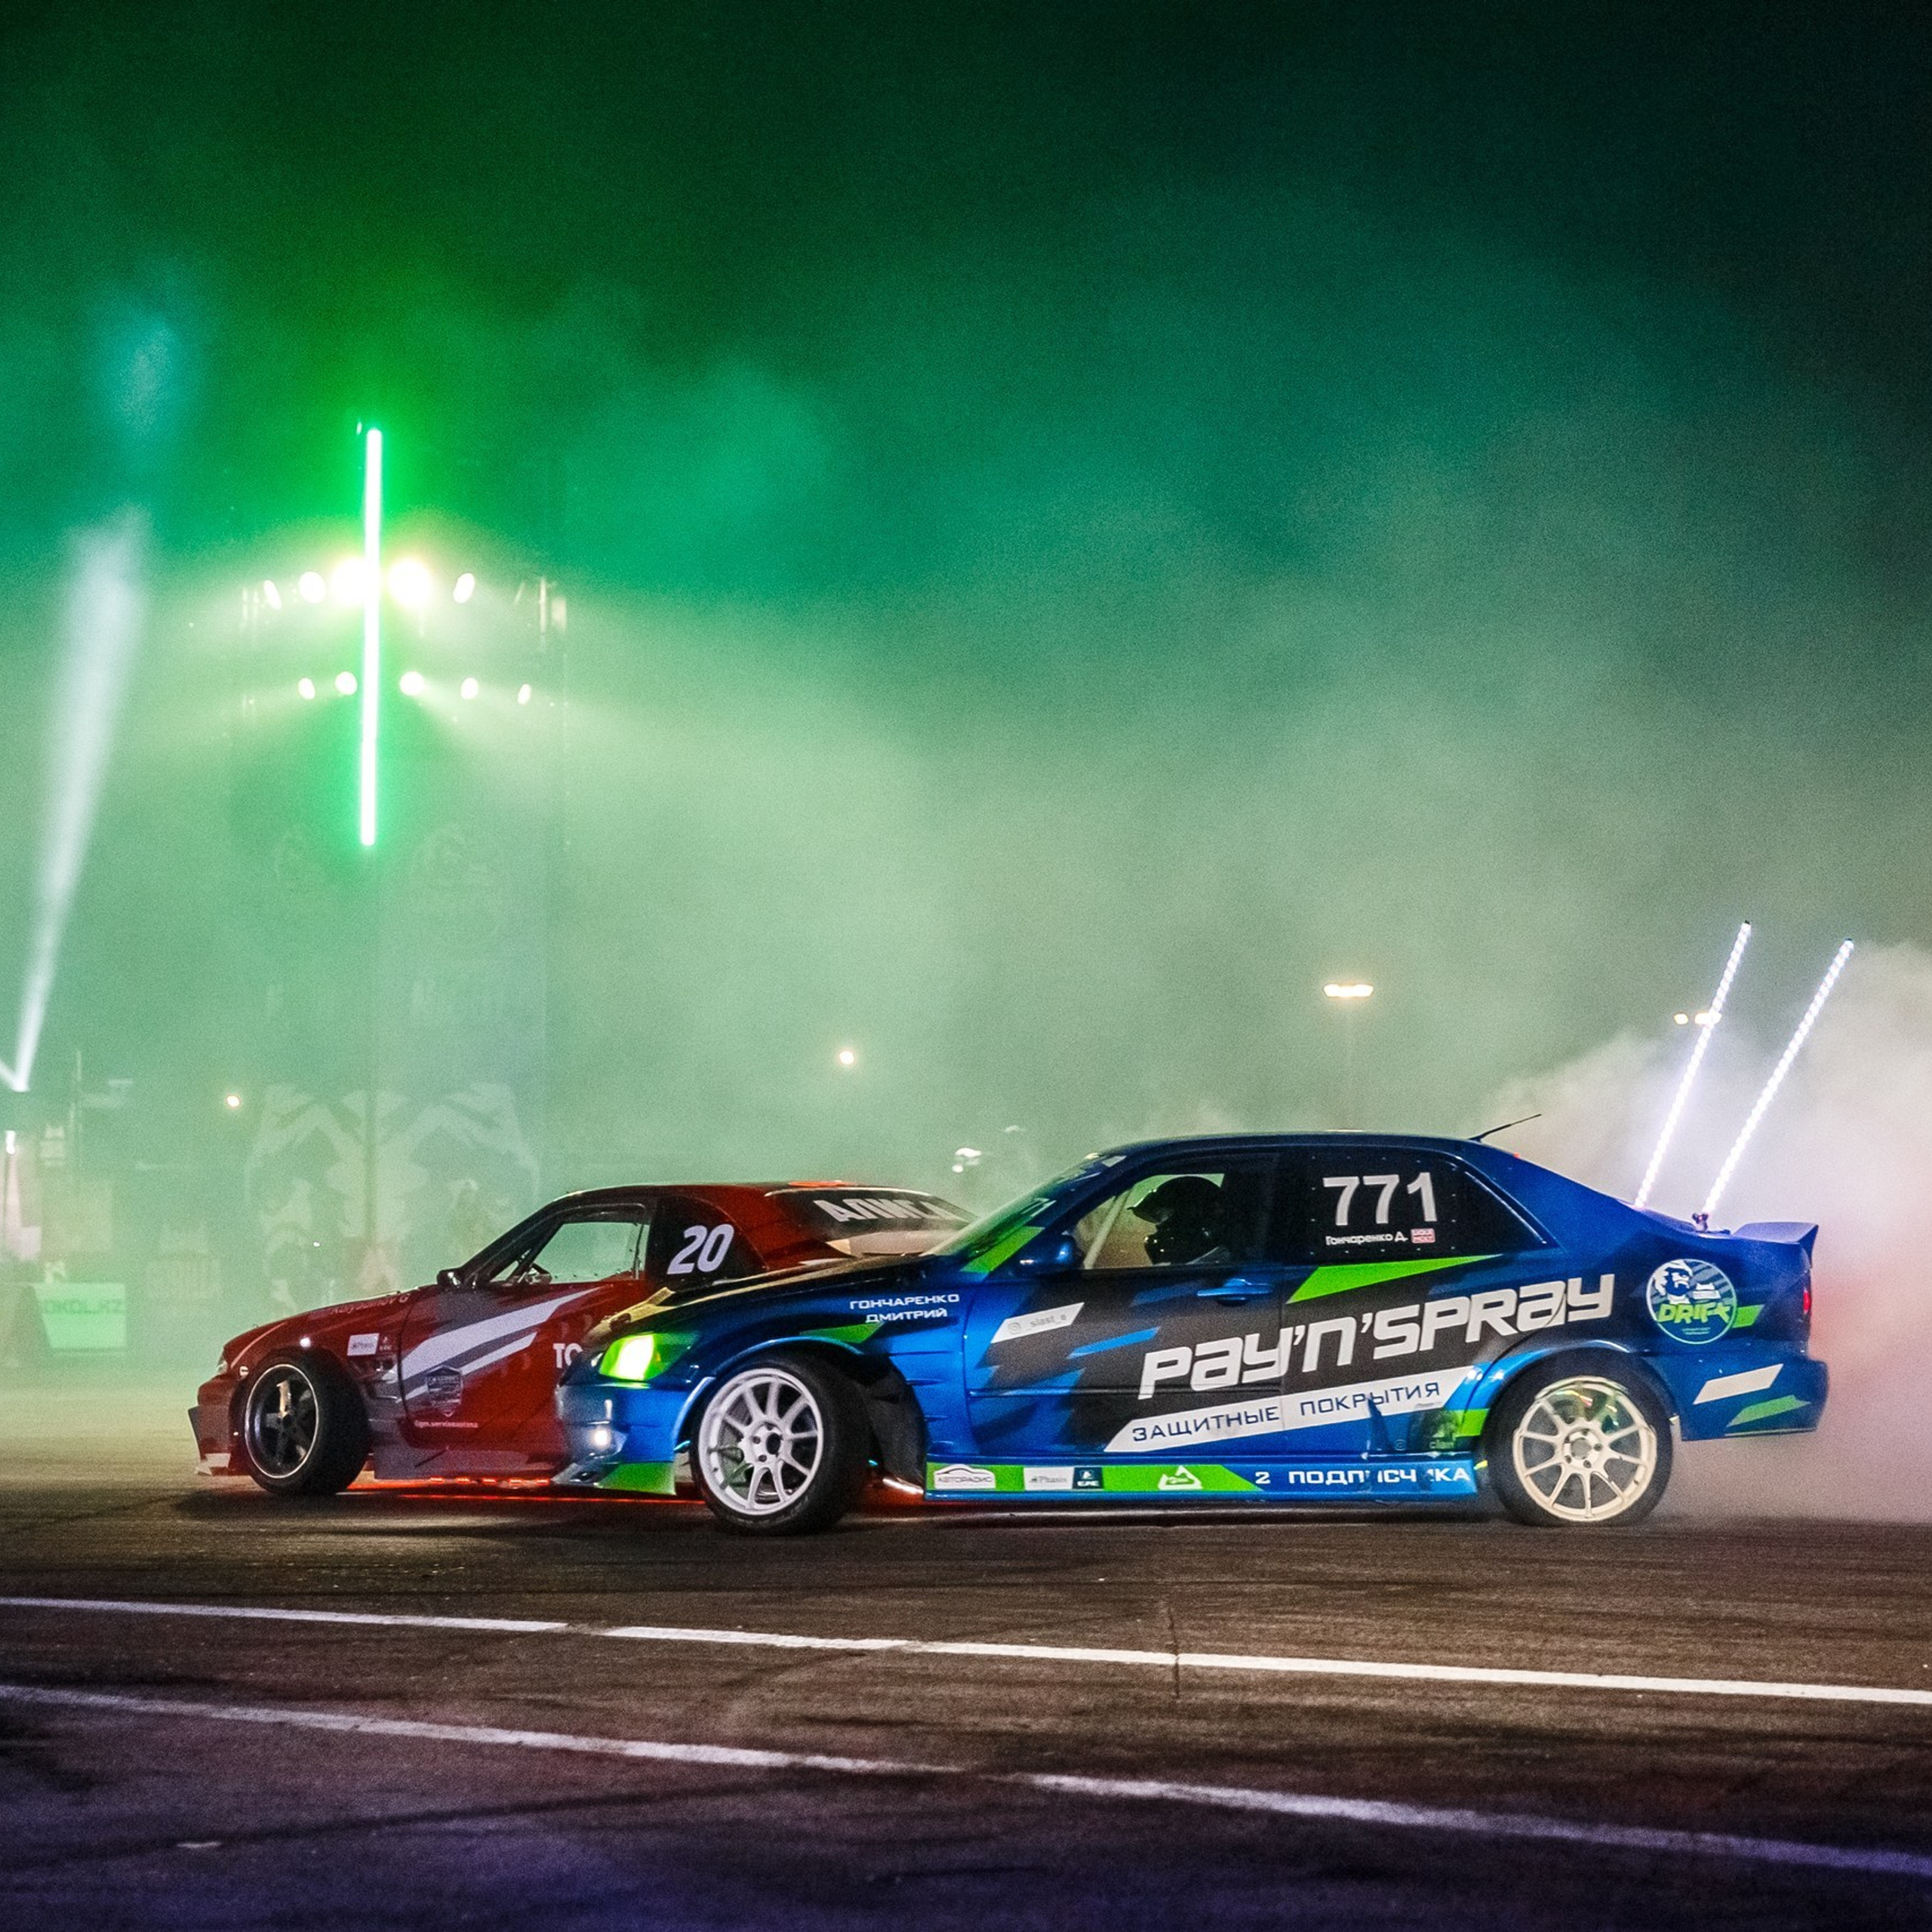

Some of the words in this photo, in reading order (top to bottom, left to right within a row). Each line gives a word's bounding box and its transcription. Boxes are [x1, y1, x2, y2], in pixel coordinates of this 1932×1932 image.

[1323, 1172, 1437, 1226] 771
[666, 1224, 734, 1275] 20
[849, 1294, 960, 1309] ГОНЧАРЕНКО
[865, 1308, 948, 1324] ДМИТРИЙ
[1657, 1302, 1731, 1324] DRIFT
[1132, 1406, 1280, 1442] ЗАЩИТНЫЕ
[1300, 1382, 1441, 1416] ПОКРЫТИЯ
[1255, 1472, 1271, 1484] 2
